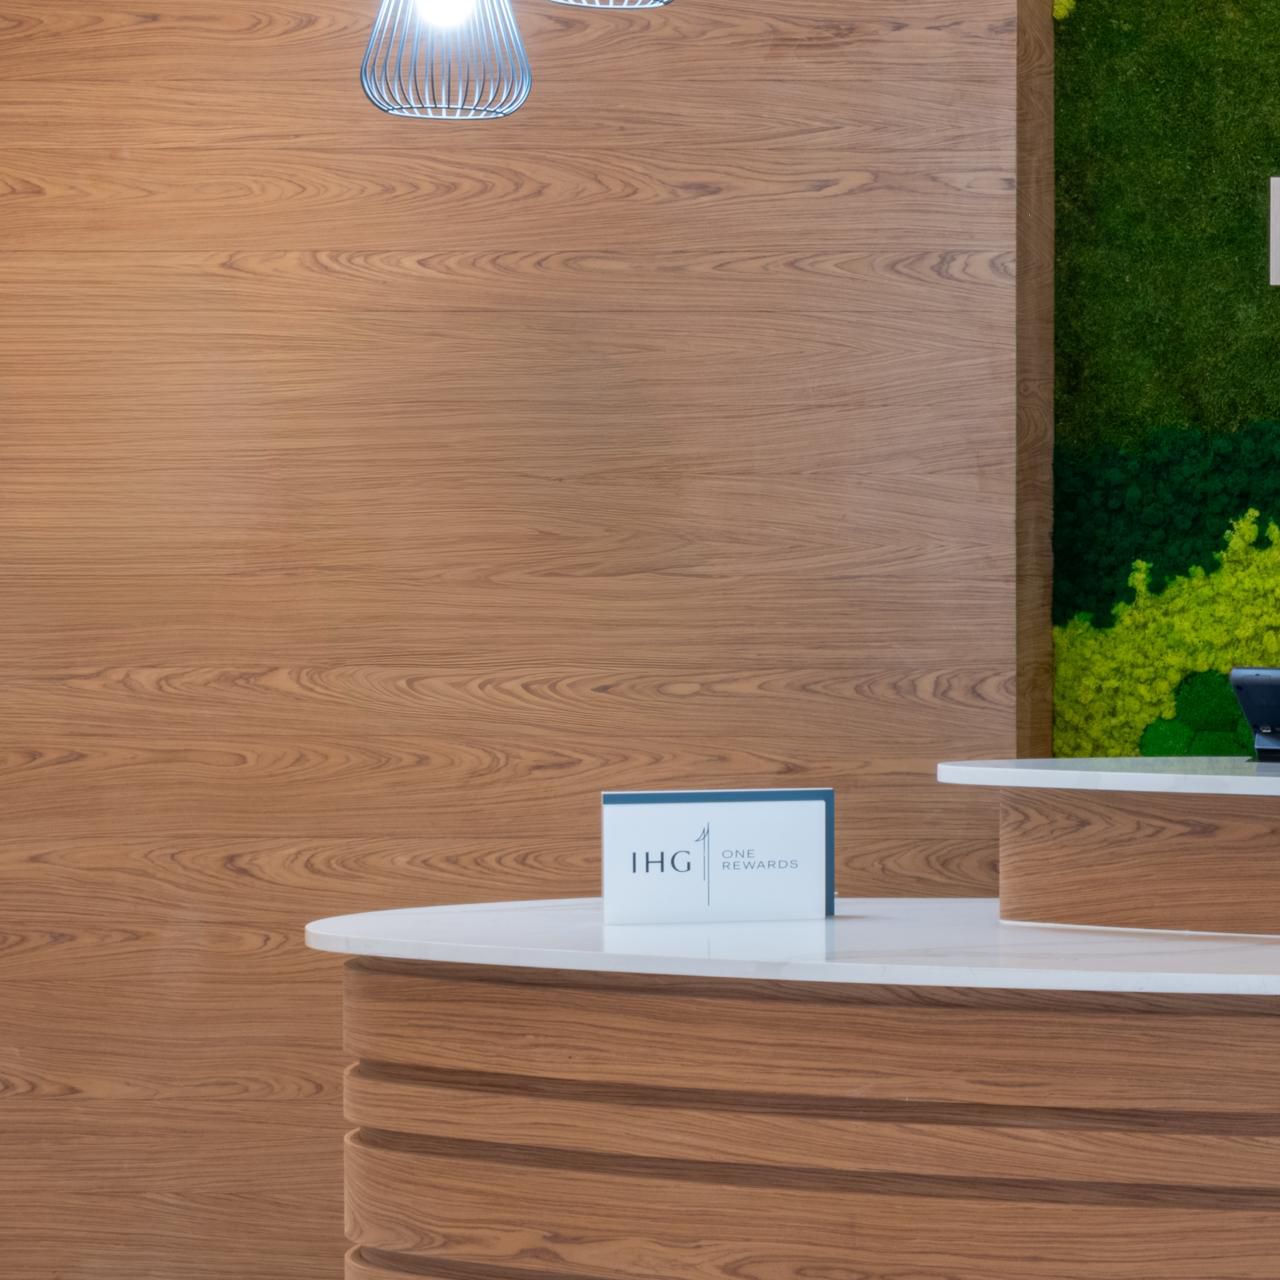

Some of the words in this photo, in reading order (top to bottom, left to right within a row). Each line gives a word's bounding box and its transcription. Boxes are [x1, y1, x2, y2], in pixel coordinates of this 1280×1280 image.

[722, 849, 755, 859] ONE
[632, 851, 691, 873] IHG
[722, 860, 799, 870] REWARDS
